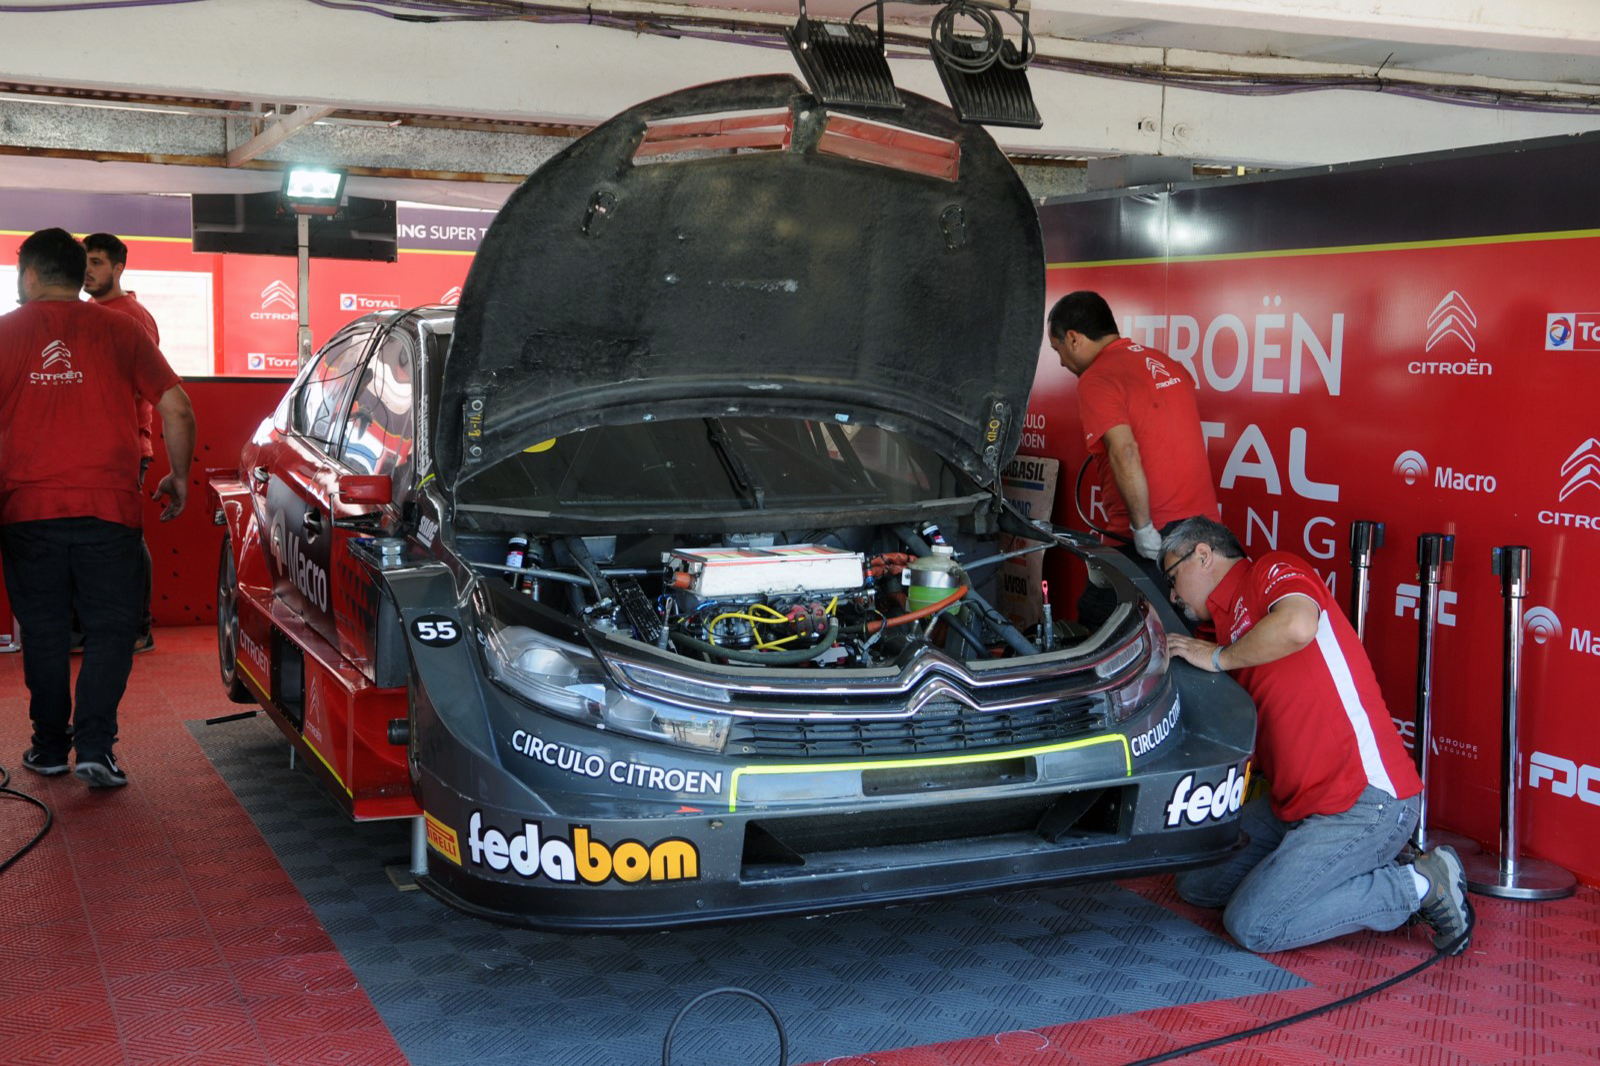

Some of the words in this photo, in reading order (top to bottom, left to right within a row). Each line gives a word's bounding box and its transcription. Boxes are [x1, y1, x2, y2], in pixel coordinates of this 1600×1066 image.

[430, 225, 476, 240] SUPER
[358, 298, 398, 308] TOTAL
[1407, 358, 1493, 376] CITROËN
[1434, 466, 1497, 494] Macro
[287, 531, 328, 614] Macro
[416, 621, 457, 641] 55
[240, 629, 270, 678] CITROËN
[1131, 718, 1170, 757] CIRCULO
[1438, 736, 1479, 753] GROUPE
[511, 729, 605, 778] CIRCULO
[609, 760, 722, 794] CITROEN
[468, 811, 698, 883] fedabom
